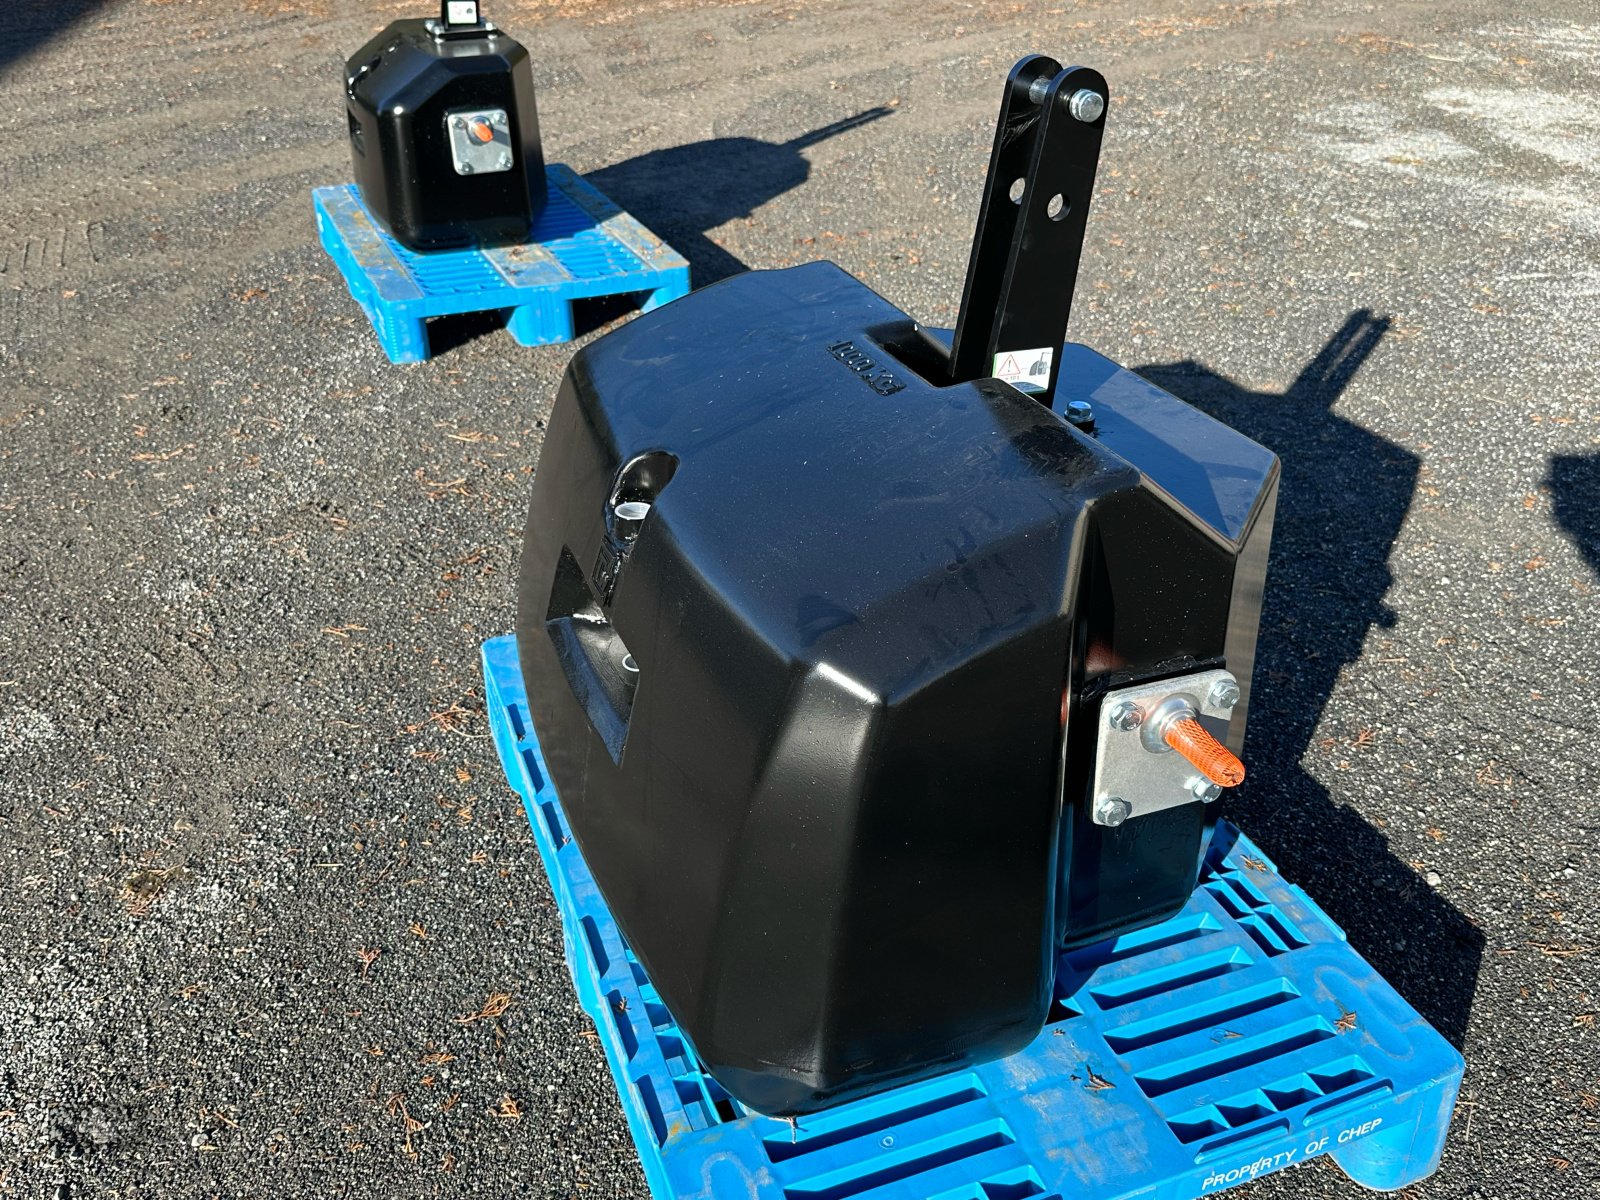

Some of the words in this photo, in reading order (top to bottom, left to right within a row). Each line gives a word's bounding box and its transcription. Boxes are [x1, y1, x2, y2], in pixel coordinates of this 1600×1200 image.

[1202, 1148, 1297, 1190] PROPERTY
[1304, 1136, 1330, 1155] OF
[1337, 1117, 1383, 1143] CHEP
